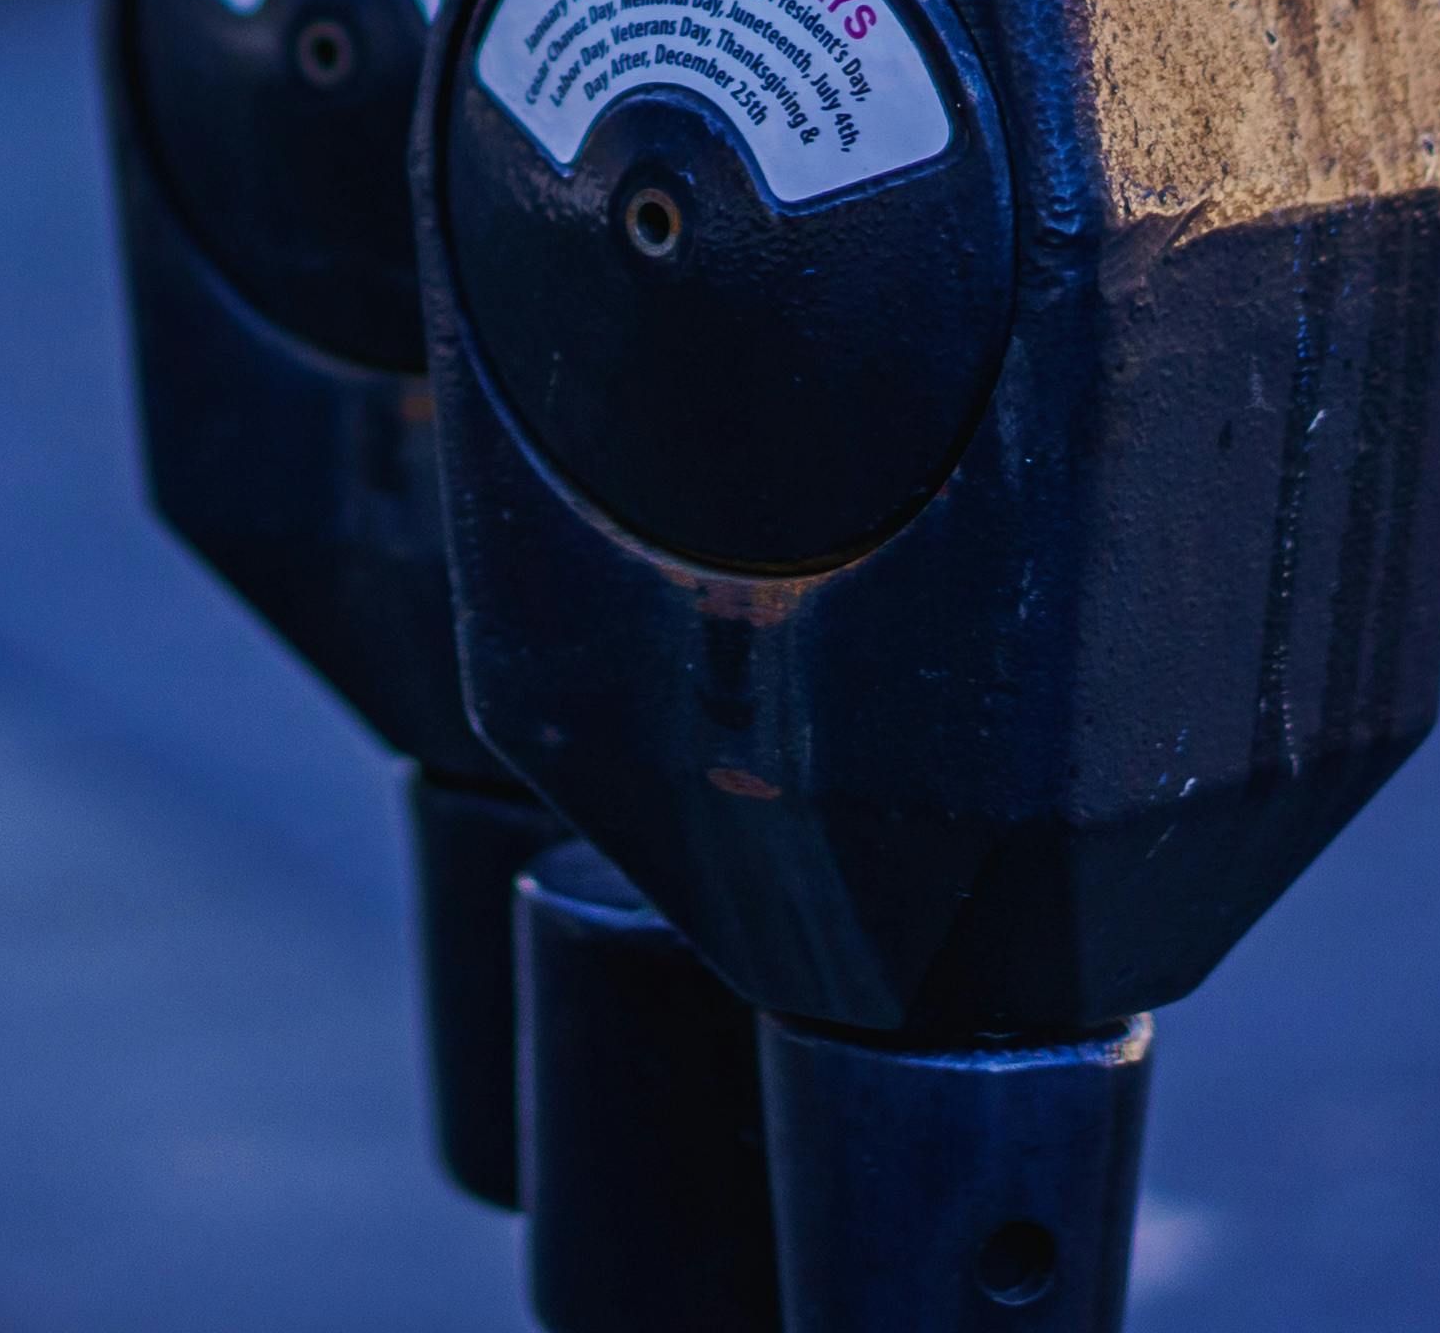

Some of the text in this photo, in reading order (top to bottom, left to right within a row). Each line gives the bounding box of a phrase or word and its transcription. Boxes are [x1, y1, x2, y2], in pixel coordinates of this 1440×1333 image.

[525, 60, 550, 105] Cesar
[547, 17, 588, 62] Chavez
[588, 0, 618, 25] Day,
[726, 0, 812, 79] Juneteenth,
[810, 73, 841, 112] July
[835, 113, 861, 153] 4th,
[550, 16, 821, 146] Labor Day, Veterans Day, Thanksgiving &
[583, 43, 769, 126] Day After, December 25th
[842, 57, 872, 102] Day,
